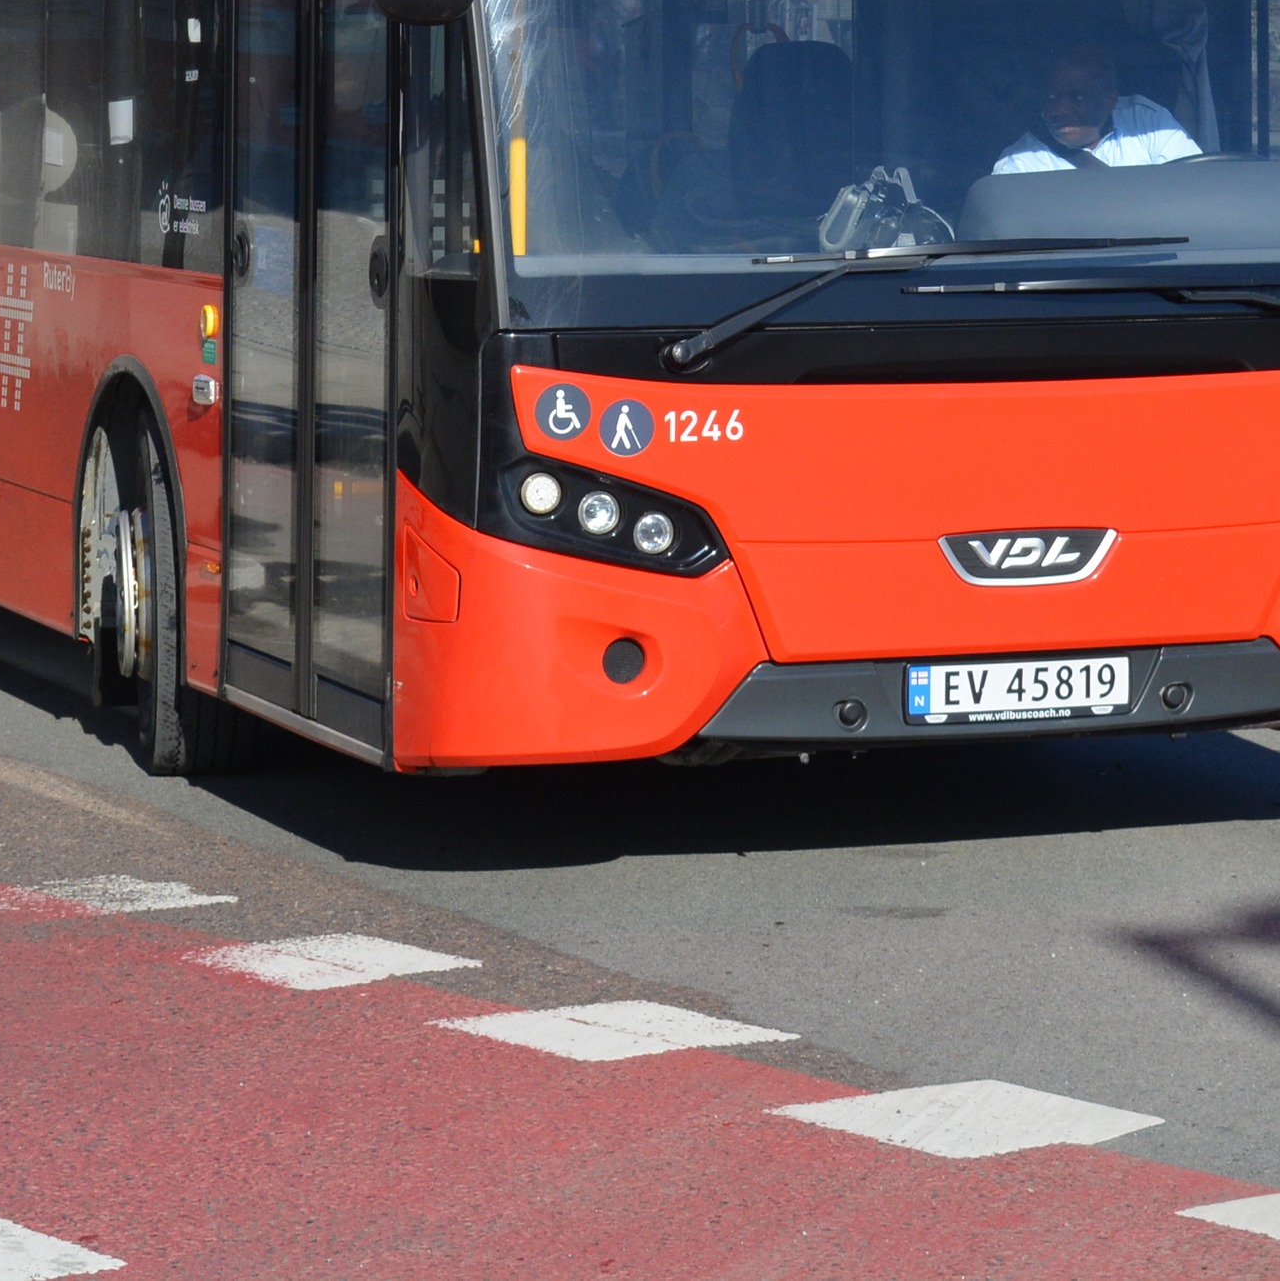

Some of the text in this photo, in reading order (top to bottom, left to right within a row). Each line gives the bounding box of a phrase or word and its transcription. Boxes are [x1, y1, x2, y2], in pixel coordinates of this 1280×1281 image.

[43, 261, 76, 301] RuterBy
[664, 409, 744, 443] 1246
[968, 536, 1081, 569] VDL
[914, 695, 925, 707] N
[944, 663, 1116, 706] EV 45819
[968, 708, 1071, 722] www.vdlbuscoach.no
